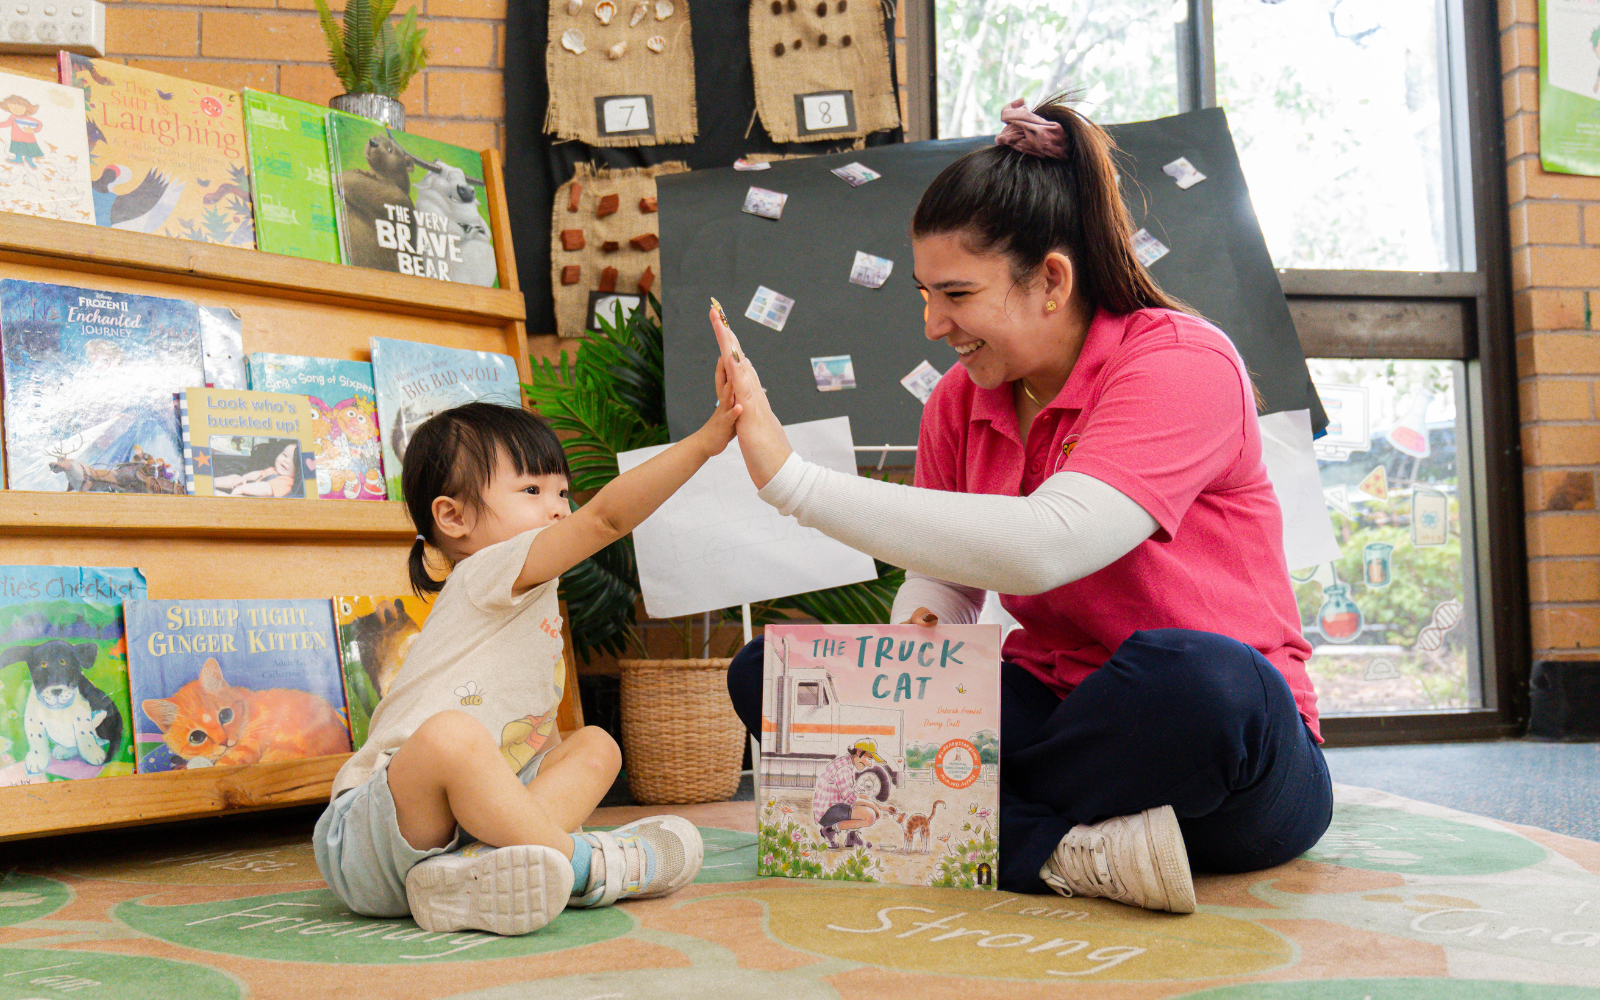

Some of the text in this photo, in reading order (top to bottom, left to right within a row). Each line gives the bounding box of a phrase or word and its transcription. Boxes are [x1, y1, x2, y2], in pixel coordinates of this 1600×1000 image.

[125, 81, 151, 97] The
[110, 90, 170, 115] Sun is
[818, 101, 832, 124] 8
[619, 105, 636, 127] 7
[101, 102, 241, 159] Laughing
[124, 140, 180, 158] Collection
[383, 203, 448, 232] THE VERY
[375, 218, 464, 263] BRAVE
[397, 251, 451, 282] BEAR
[78, 296, 129, 312] FROZEN II
[67, 305, 143, 329] Enchanted
[80, 325, 132, 338] JOURNEY
[265, 376, 291, 392] Sing
[298, 373, 326, 387] Song
[327, 375, 337, 385] of
[402, 367, 502, 400] BIG BAD WOLF
[207, 395, 297, 414] Look who's
[207, 414, 300, 433] buckled up!
[0, 575, 137, 600] lie's Checklist
[166, 606, 240, 631] SLEEP
[147, 629, 328, 657] GINGER KITTEN
[812, 635, 965, 668] THE TRUCK
[872, 672, 932, 703] CAT
[983, 897, 1091, 921] I am
[827, 905, 1148, 977] Strong
